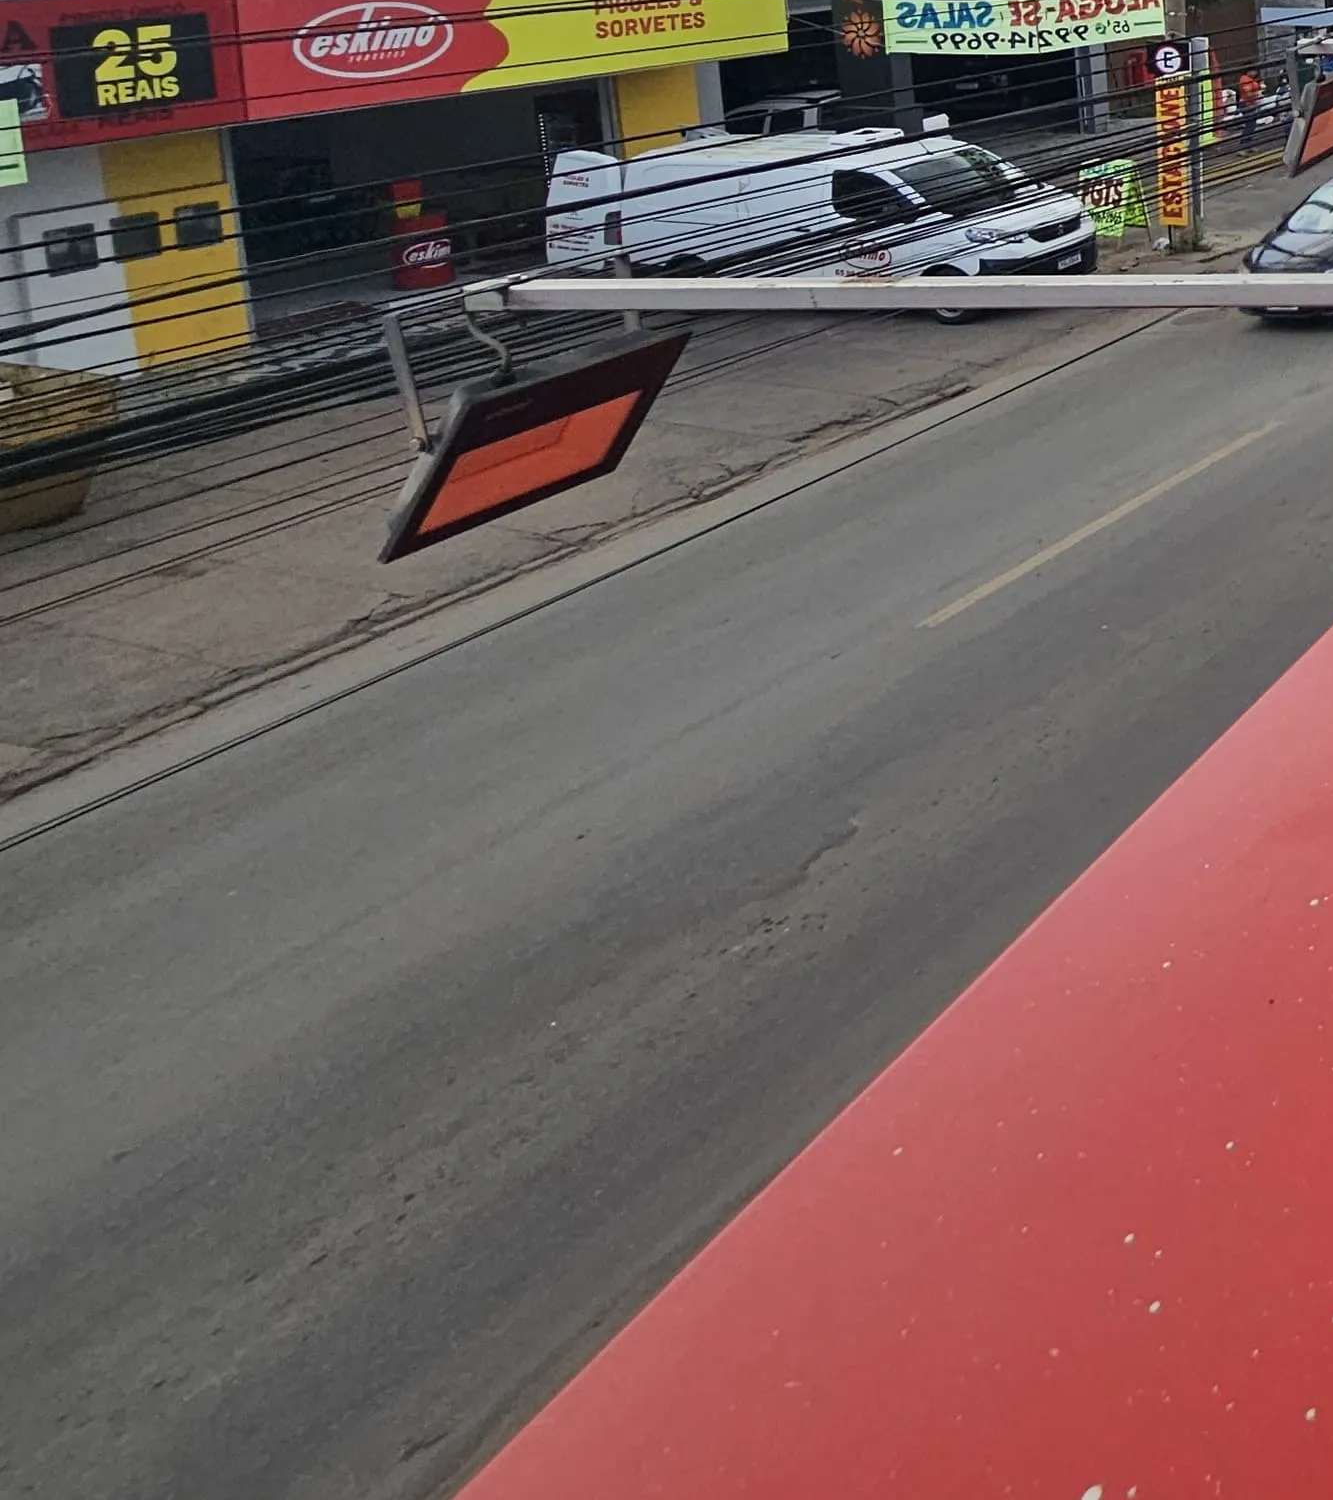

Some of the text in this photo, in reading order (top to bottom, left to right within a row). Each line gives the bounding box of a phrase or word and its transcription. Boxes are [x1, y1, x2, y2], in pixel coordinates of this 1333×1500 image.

[310, 4, 437, 58] eskimo
[595, 11, 706, 40] SORVETES
[92, 23, 177, 83] 25
[97, 76, 181, 107] REAIS
[408, 241, 451, 262] eskim
